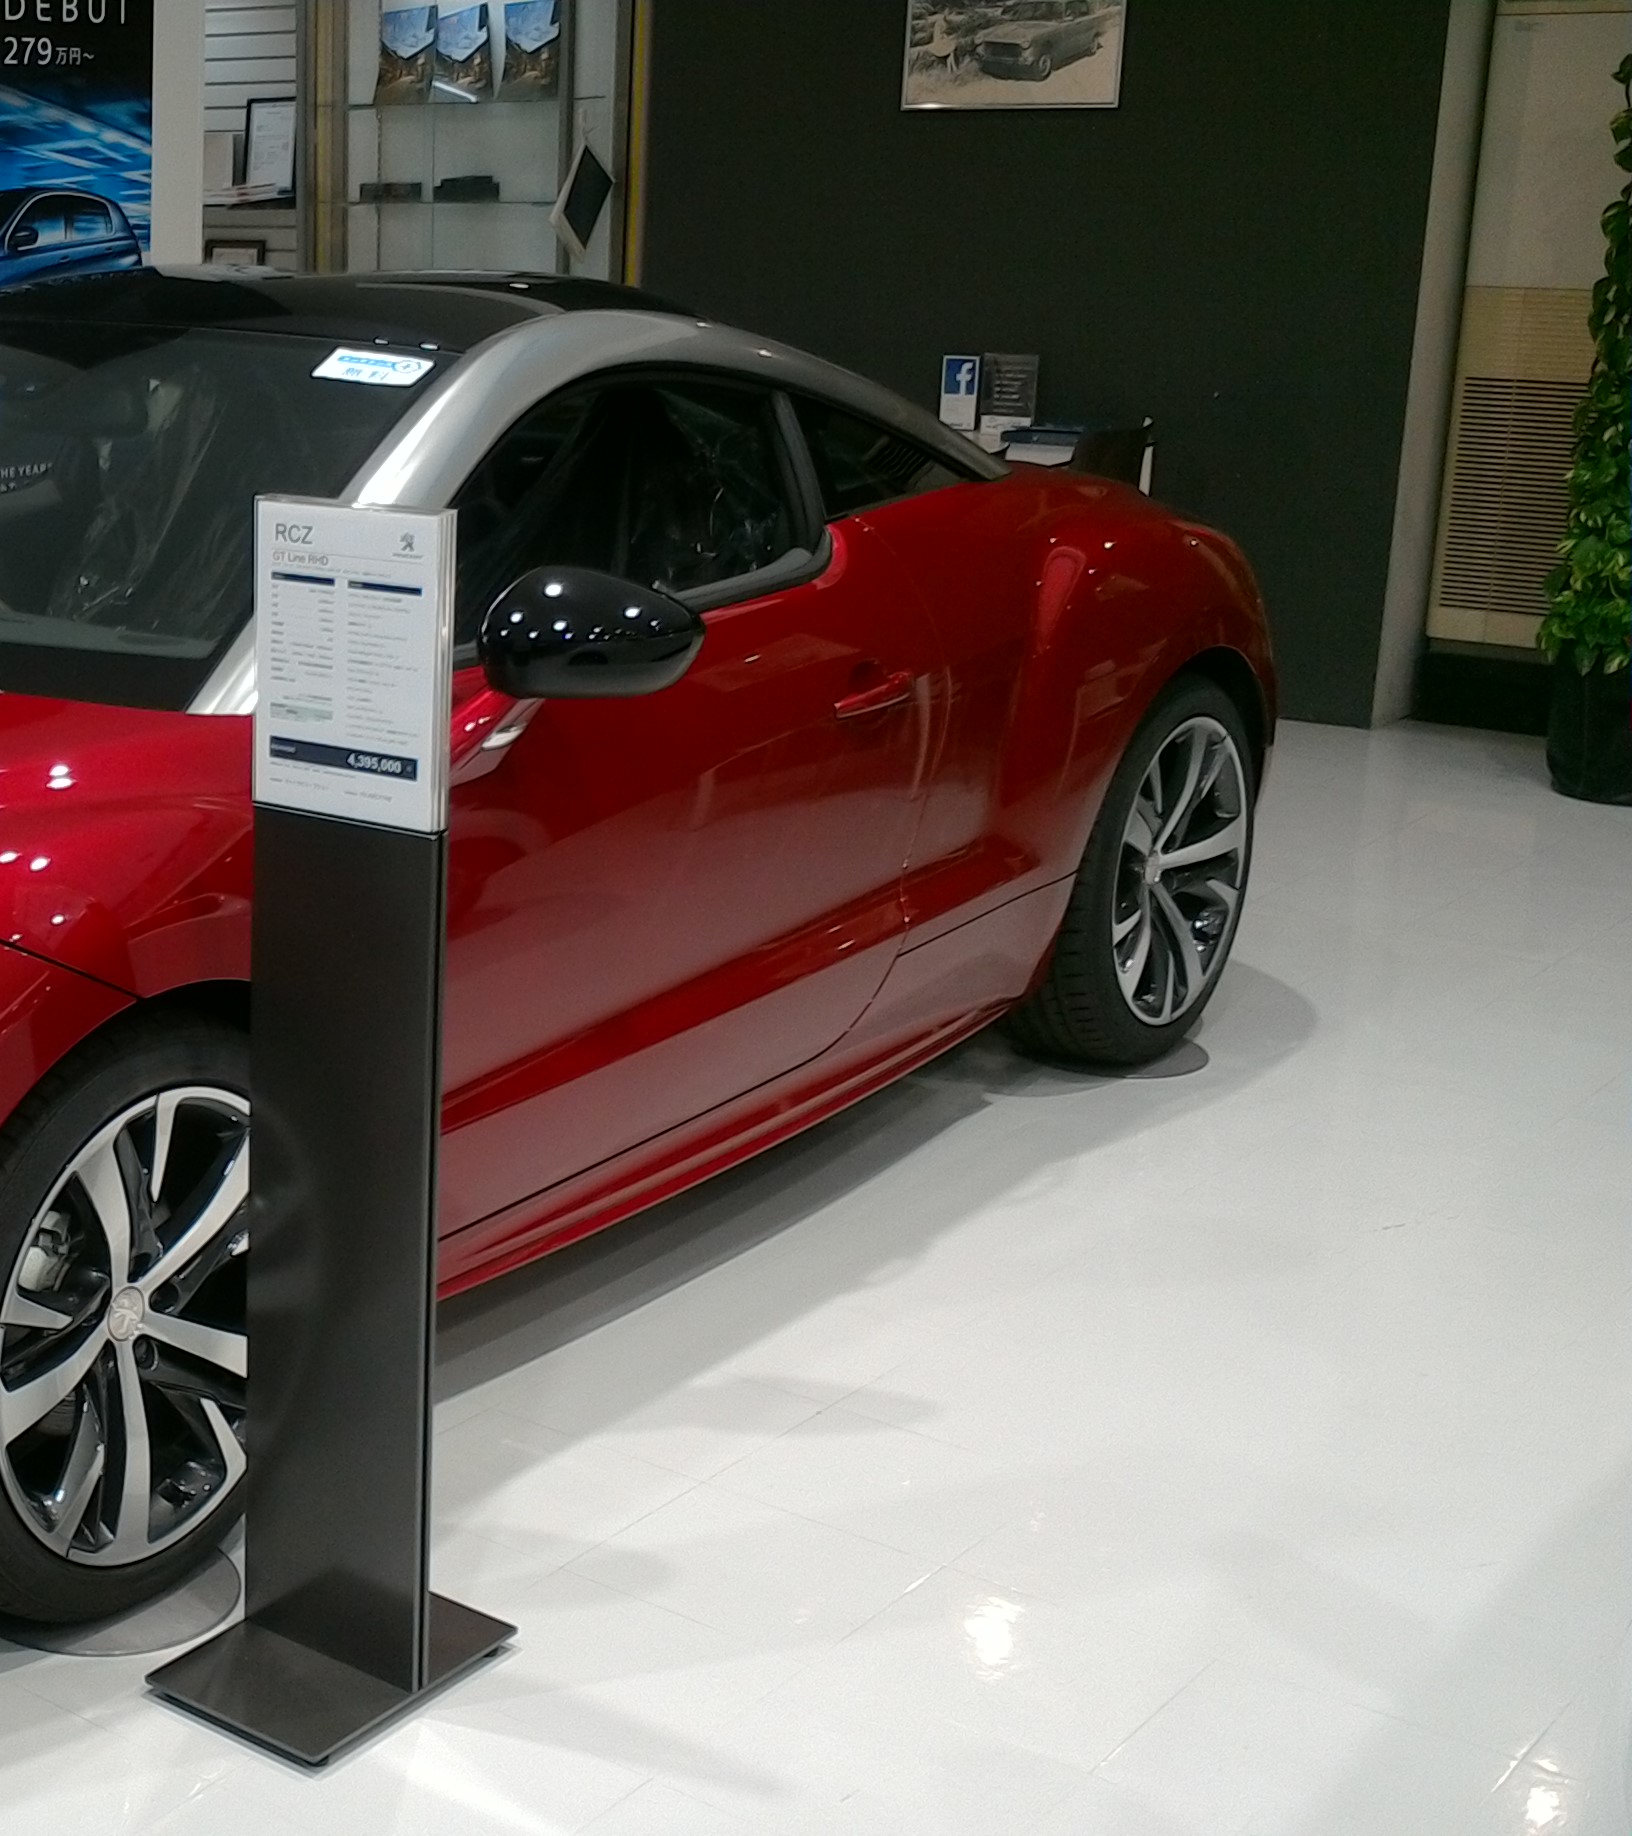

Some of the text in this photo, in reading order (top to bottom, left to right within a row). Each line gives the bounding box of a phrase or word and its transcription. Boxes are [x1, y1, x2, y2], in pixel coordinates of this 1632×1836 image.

[274, 523, 313, 545] RCZ
[287, 553, 306, 565] Line
[347, 752, 402, 774] 4,395,000
